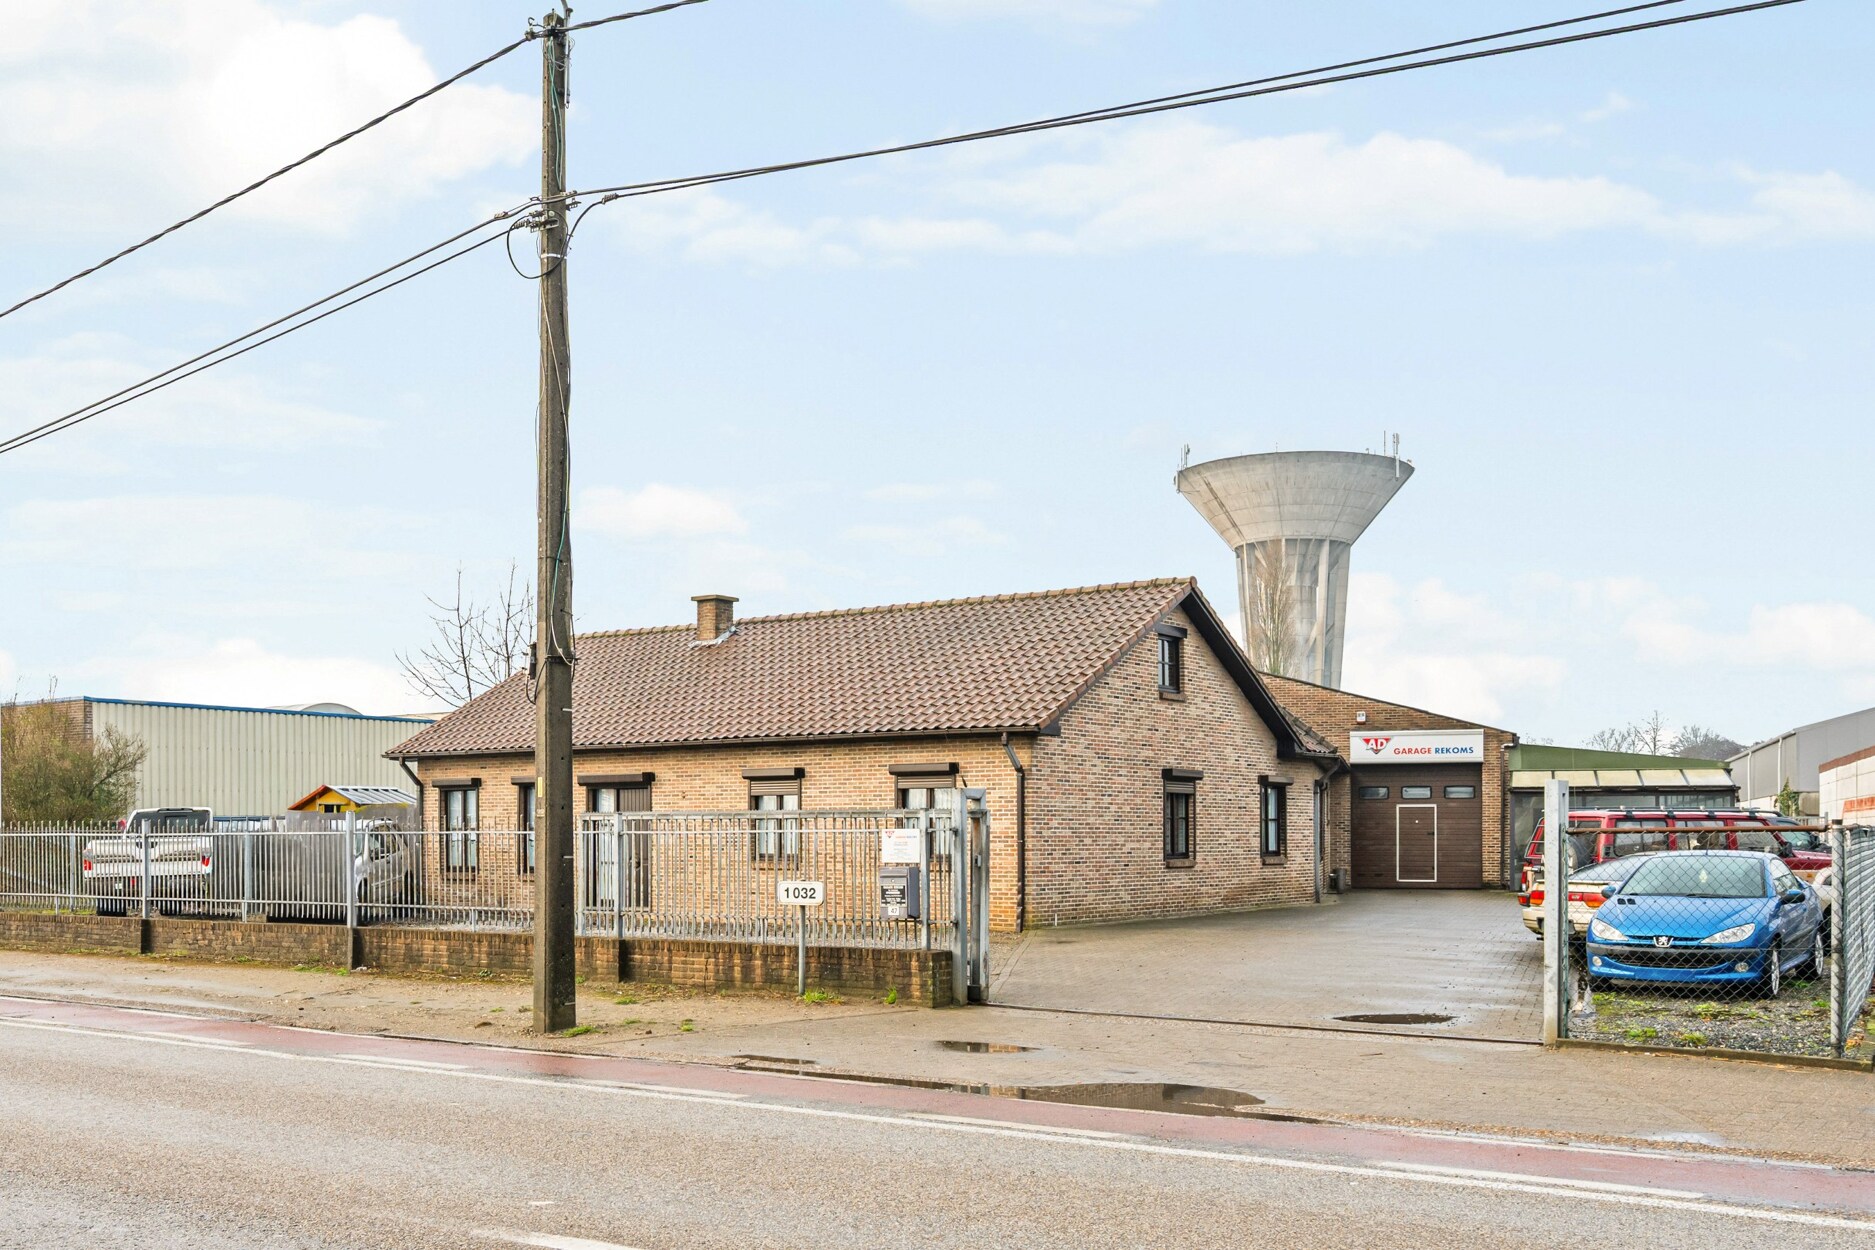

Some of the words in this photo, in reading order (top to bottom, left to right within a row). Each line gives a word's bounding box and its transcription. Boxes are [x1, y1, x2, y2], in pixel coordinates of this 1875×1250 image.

[1366, 738, 1388, 750] AD
[1393, 747, 1432, 755] GARAGE
[1434, 746, 1474, 754] REKOMS
